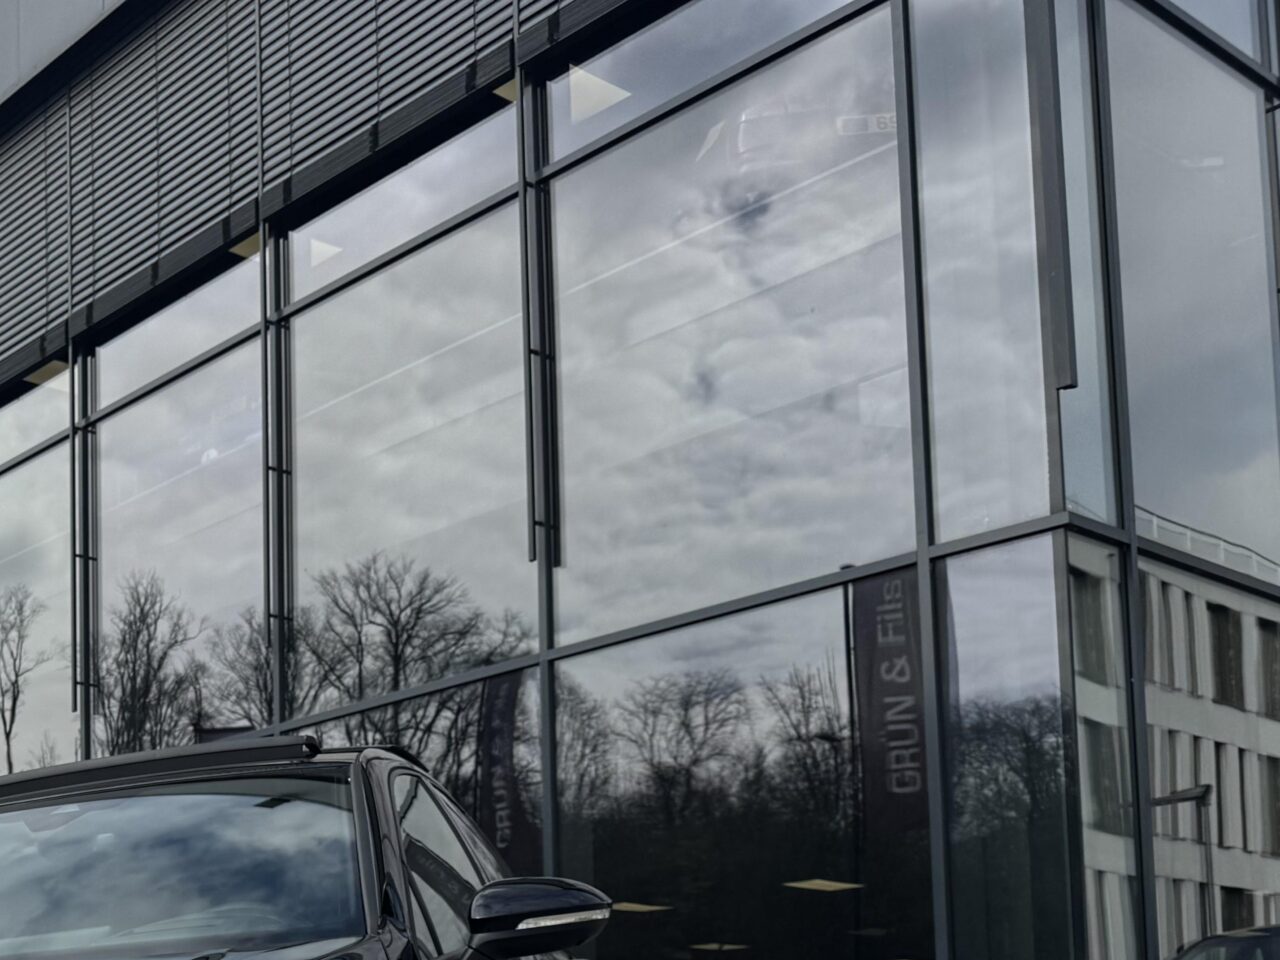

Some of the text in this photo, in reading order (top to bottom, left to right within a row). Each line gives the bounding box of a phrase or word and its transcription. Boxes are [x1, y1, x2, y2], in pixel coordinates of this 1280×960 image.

[877, 579, 921, 794] GRÜN & Fils
